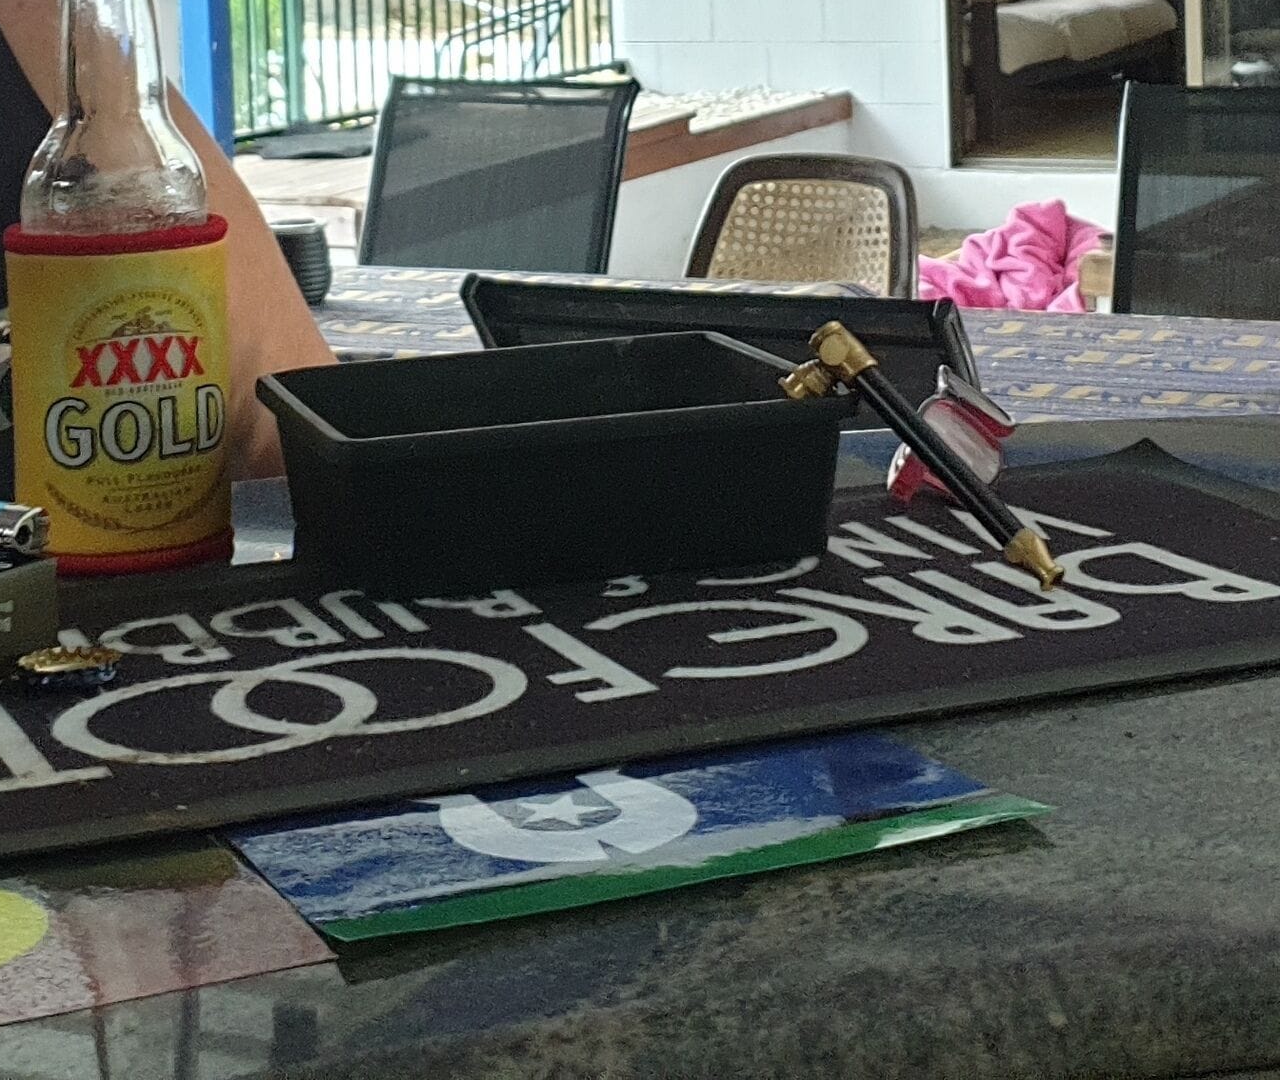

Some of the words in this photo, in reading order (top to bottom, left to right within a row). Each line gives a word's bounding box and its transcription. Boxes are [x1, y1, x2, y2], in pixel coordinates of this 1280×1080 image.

[70, 335, 205, 388] XXXX
[45, 384, 226, 469] GOLD
[696, 503, 1114, 587] WIN
